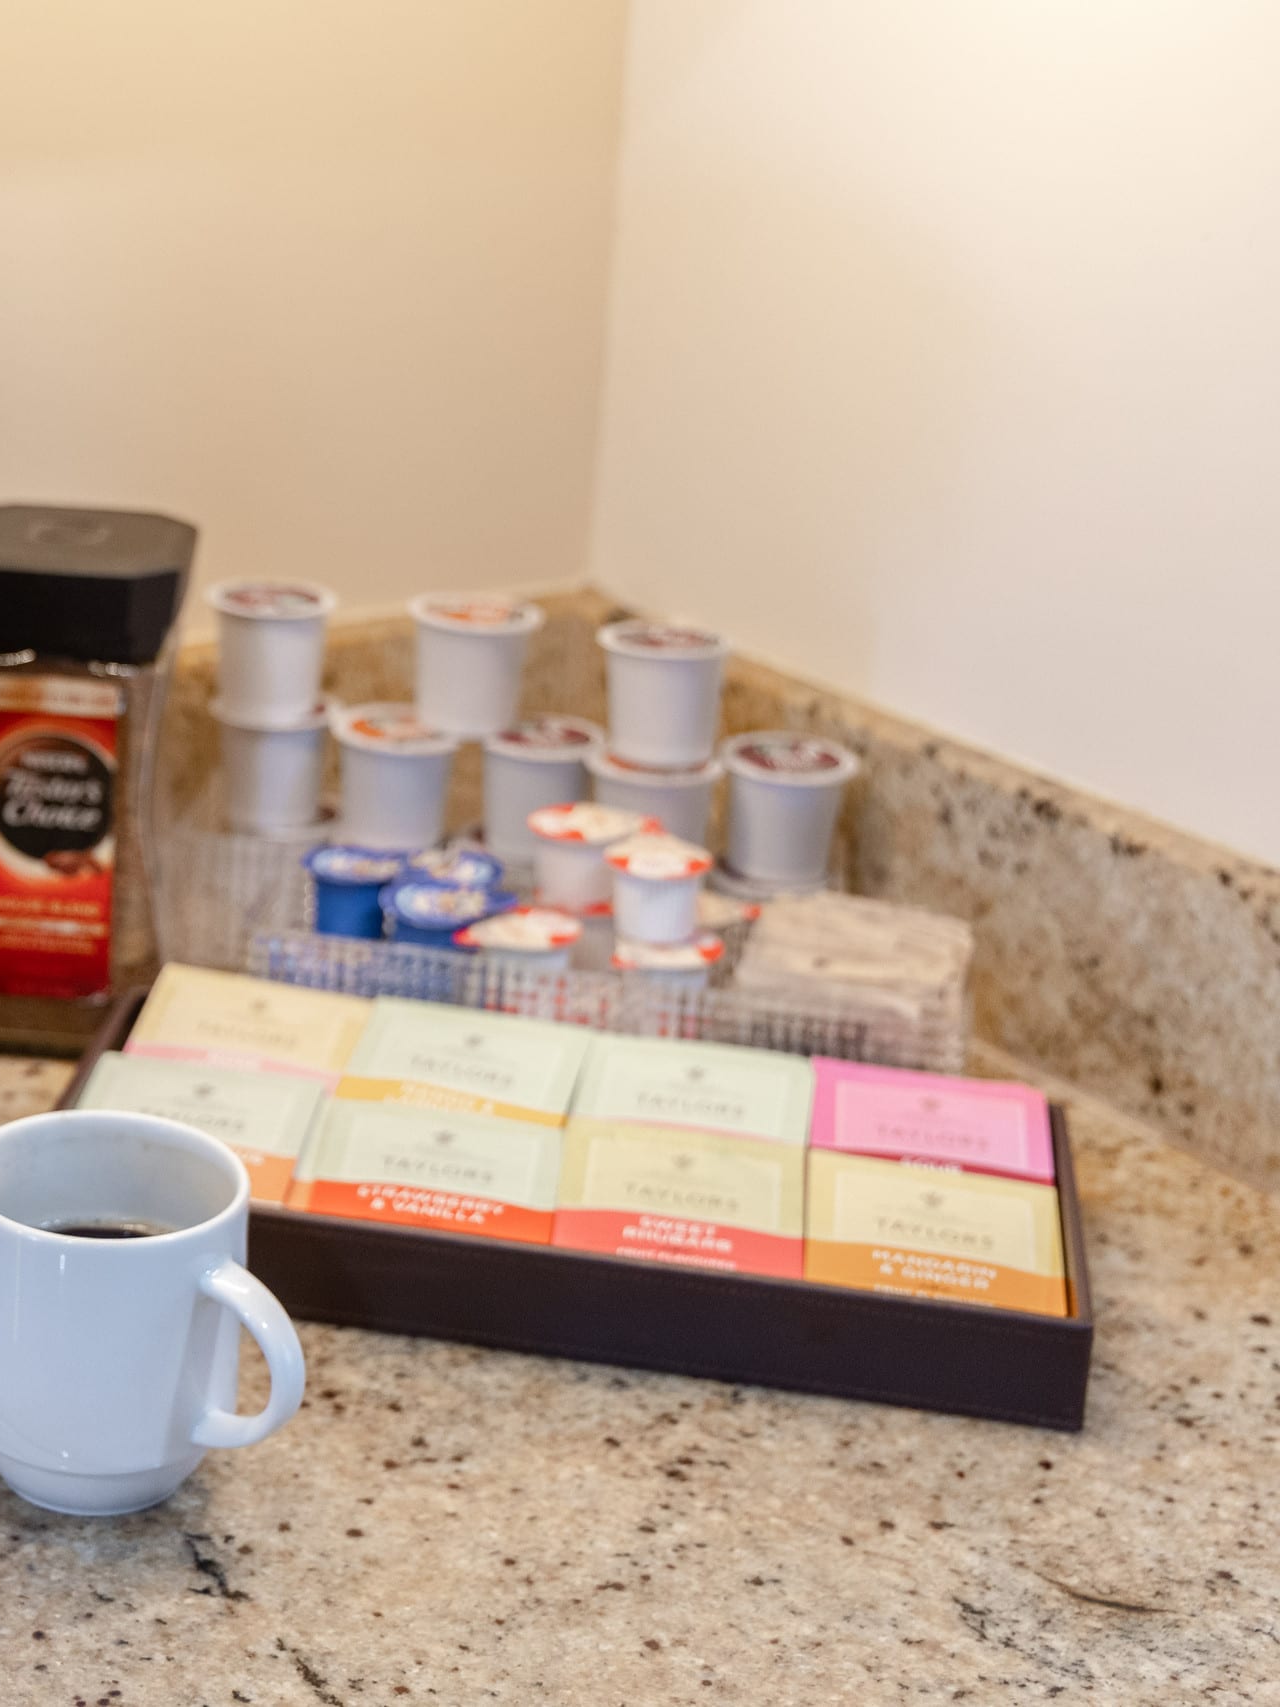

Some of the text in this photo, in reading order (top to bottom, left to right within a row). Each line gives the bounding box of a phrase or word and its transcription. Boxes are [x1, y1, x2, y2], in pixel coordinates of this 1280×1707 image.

[409, 1053, 515, 1089] TAYLORS
[637, 1090, 745, 1119] TAYLORS
[876, 1121, 989, 1152] TAYLORS
[383, 1154, 495, 1184] TAYLORS
[357, 1183, 504, 1216] STRAWBERRY
[371, 1196, 486, 1225] & VANILLA
[624, 1180, 740, 1213] TAYLORS
[623, 1224, 733, 1253] RHUBARB
[639, 1214, 717, 1237] SWEET
[877, 1215, 995, 1251] TAYLORS
[871, 1249, 999, 1281] MANDARIN
[879, 1262, 990, 1291] & GINGER
